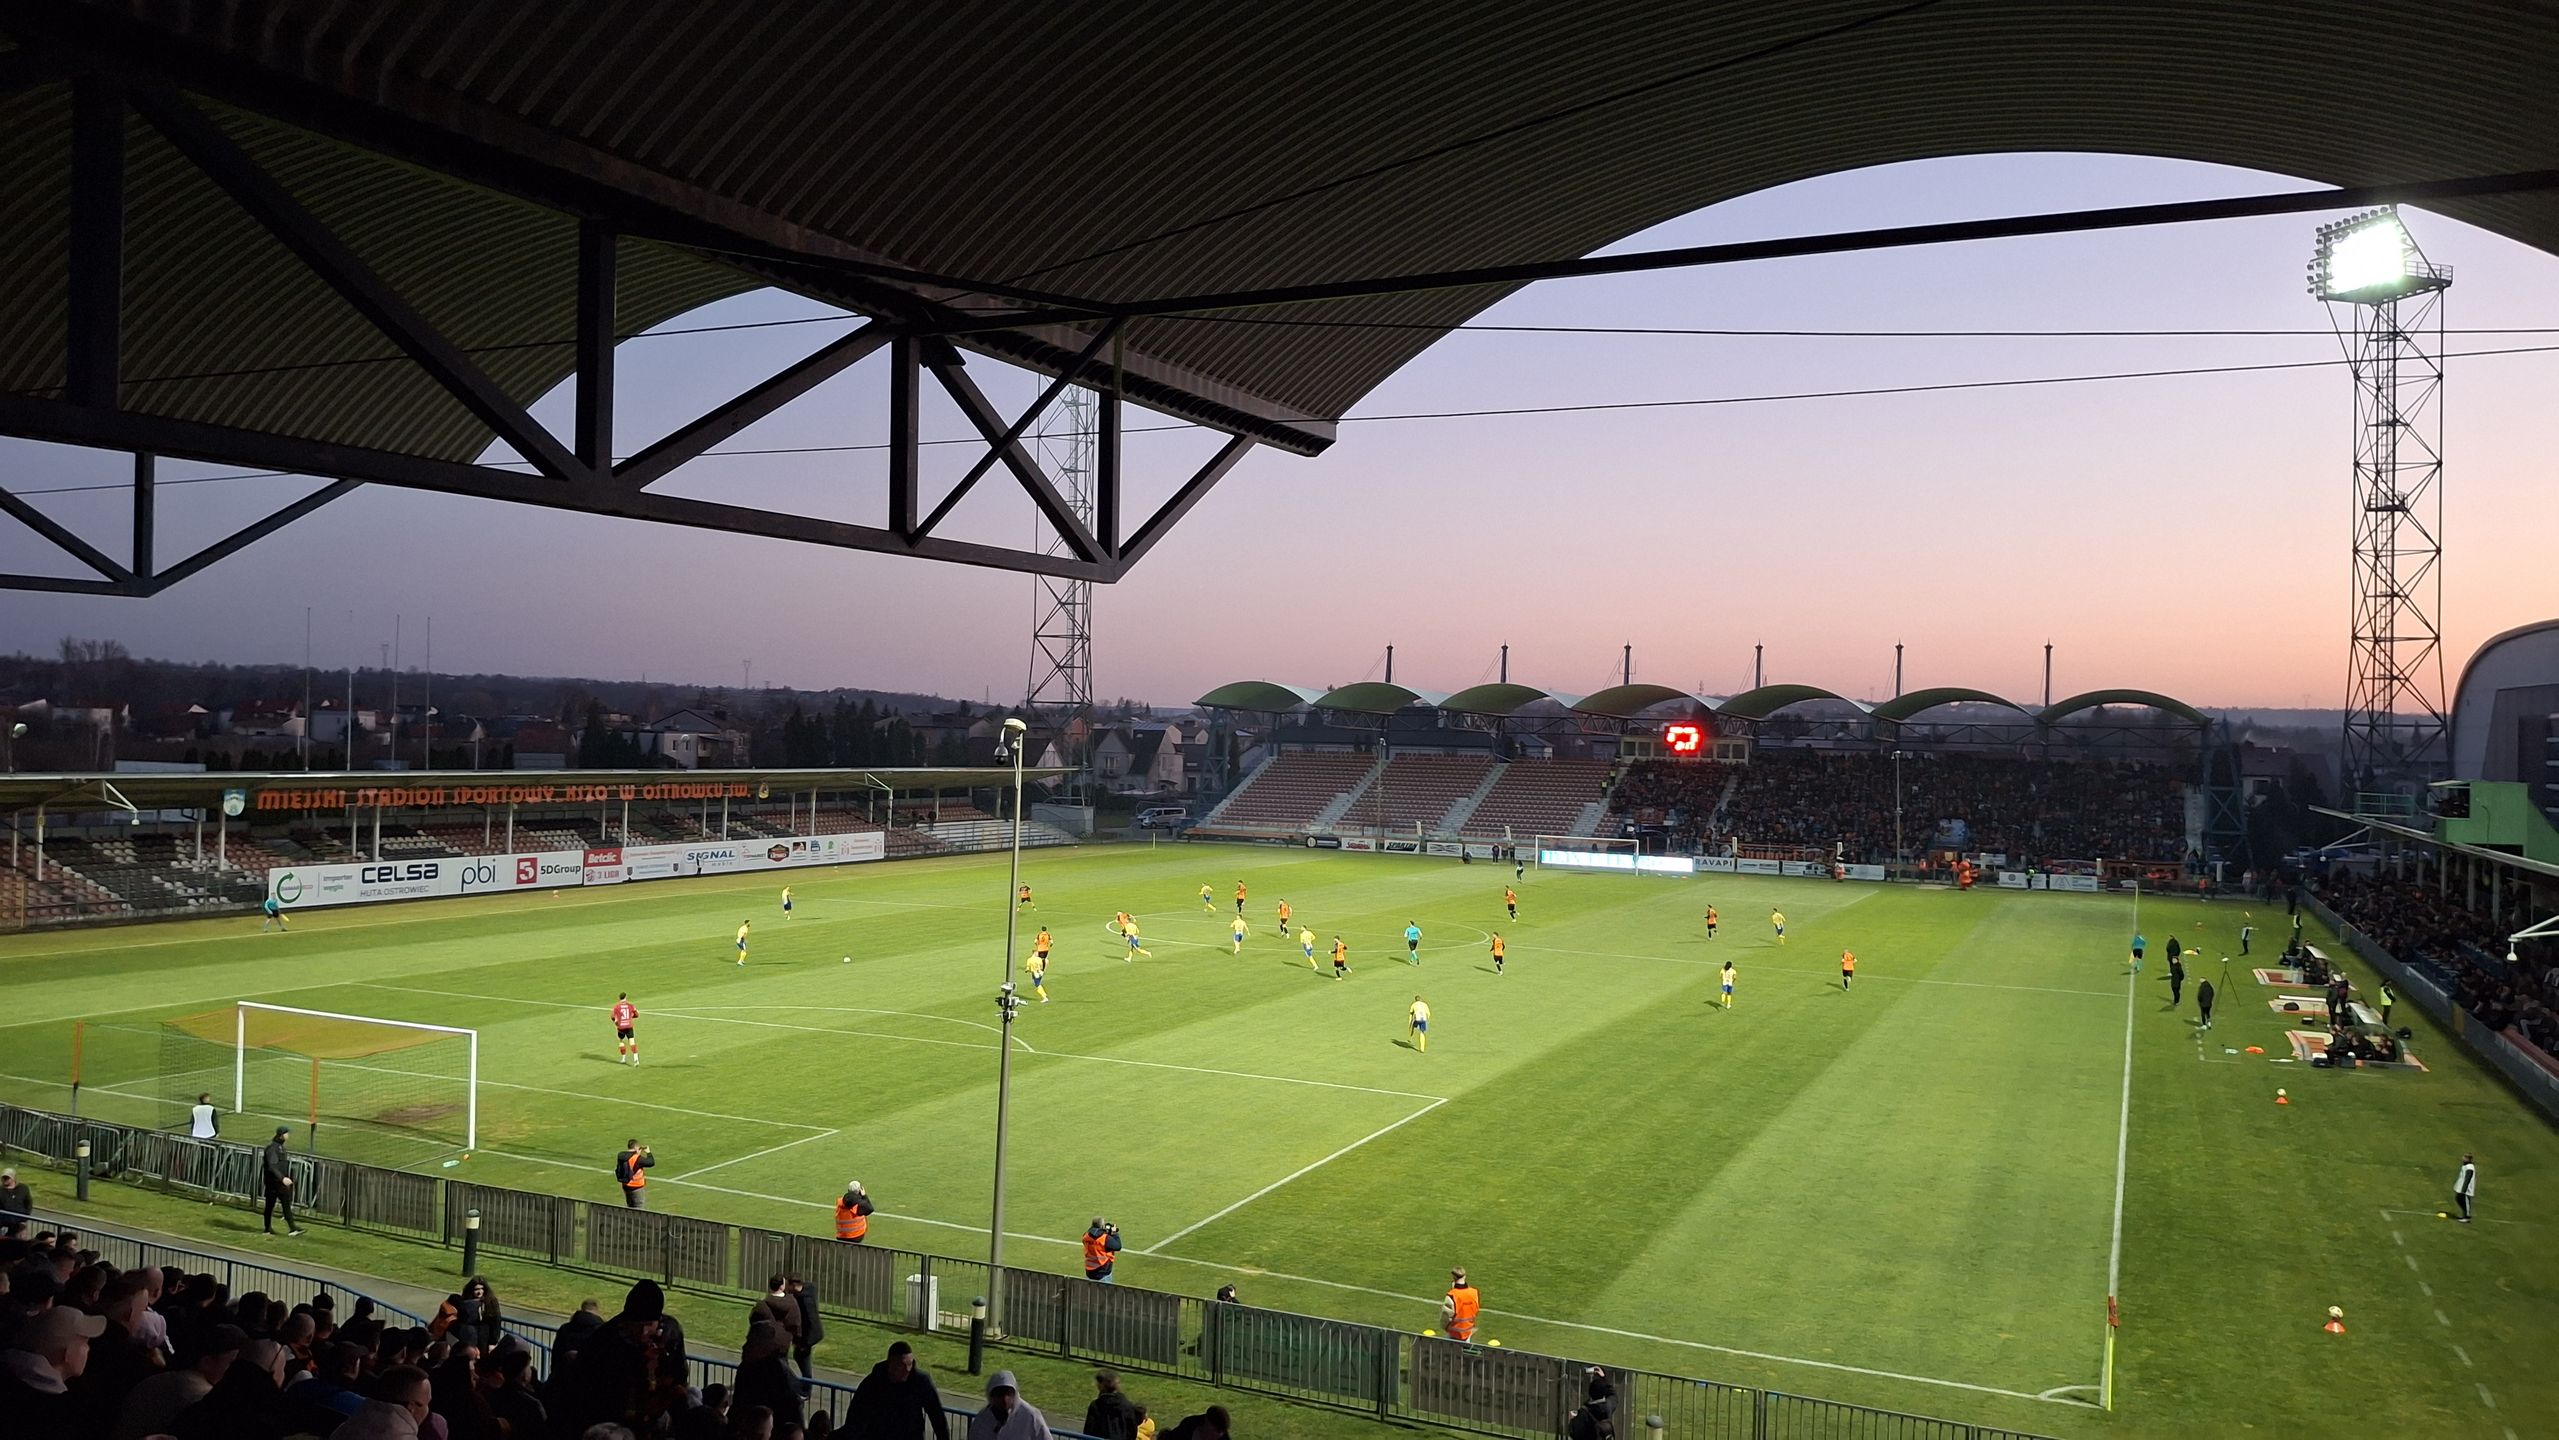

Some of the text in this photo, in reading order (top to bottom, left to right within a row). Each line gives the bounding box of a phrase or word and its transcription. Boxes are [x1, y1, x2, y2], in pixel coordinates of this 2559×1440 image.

[257, 788, 346, 810] MIEJSKI
[357, 787, 444, 806] STADION
[453, 785, 554, 805] SPORTOWY
[619, 785, 635, 801] W
[643, 783, 723, 801] OSTROWCU
[687, 849, 735, 861] SIGNAL
[461, 858, 496, 892] pbi
[540, 864, 581, 875] 5DGroup
[360, 885, 429, 897] HUTA OSTROWIEC
